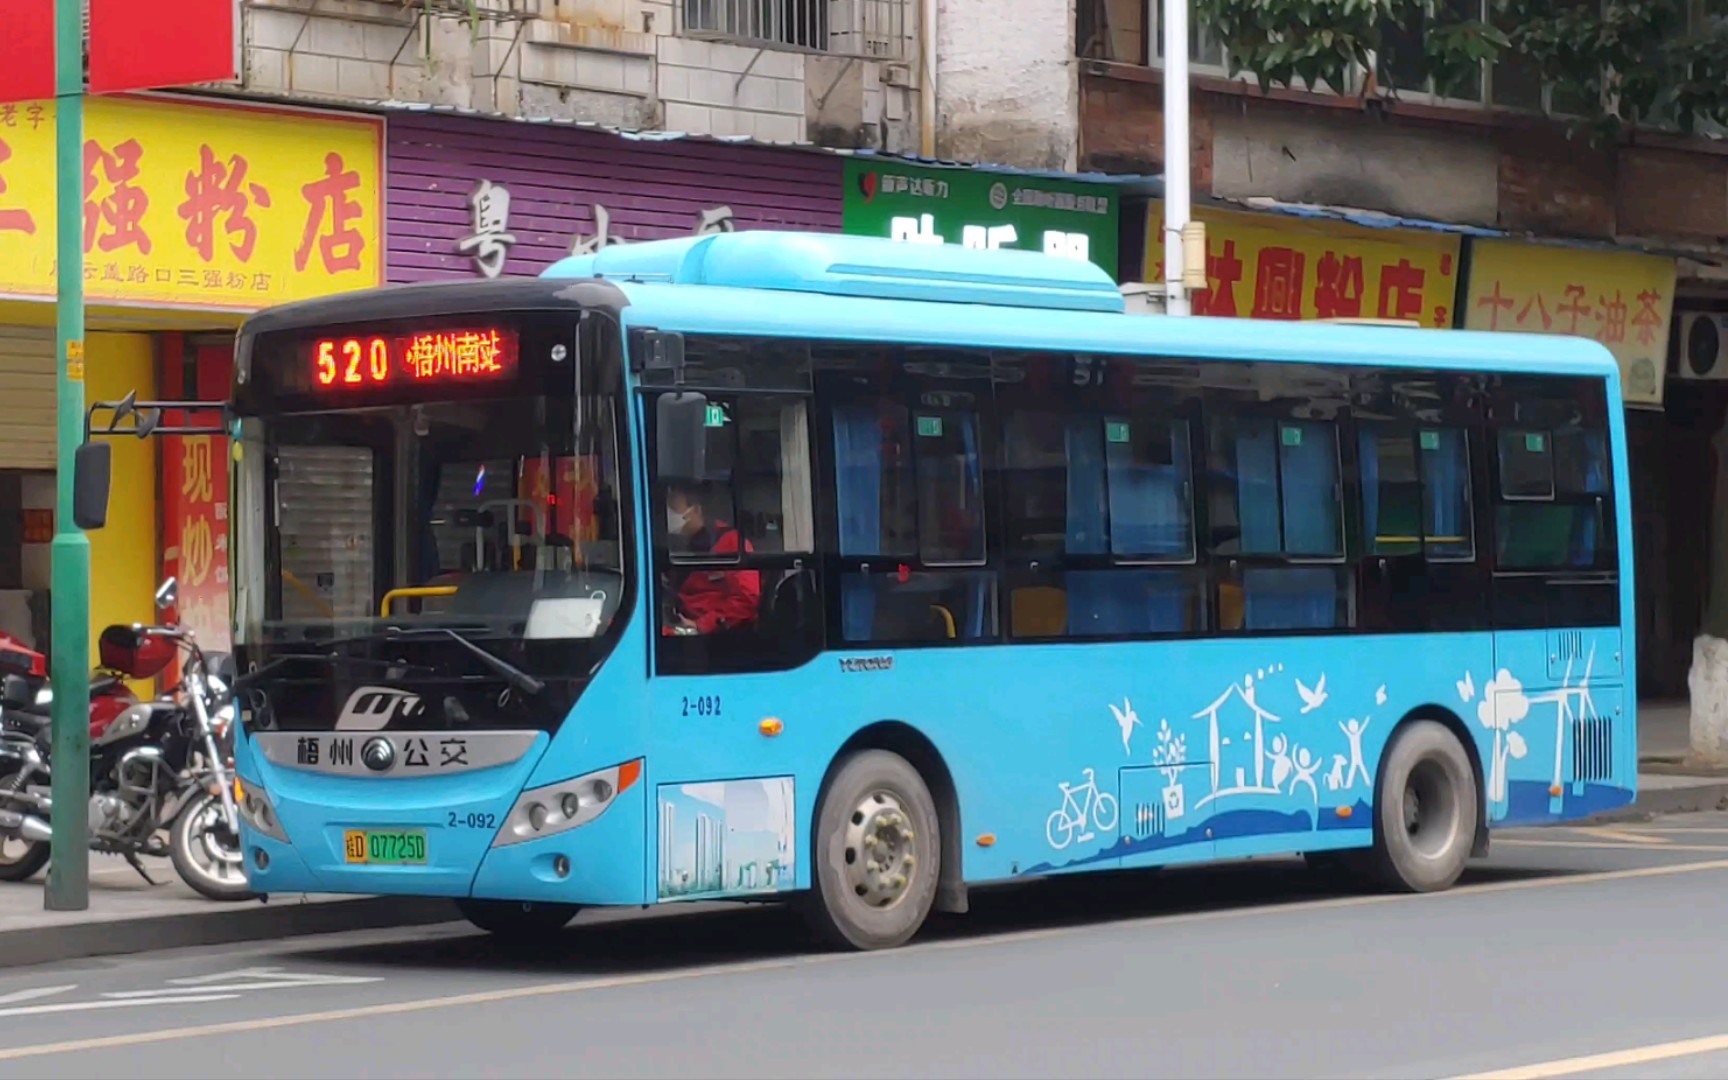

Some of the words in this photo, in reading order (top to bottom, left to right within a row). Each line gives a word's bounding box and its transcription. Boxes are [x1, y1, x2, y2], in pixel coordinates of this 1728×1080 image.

[0, 104, 57, 130] 老字
[1477, 280, 1663, 345] 十八子油茶
[318, 338, 388, 384] 520
[411, 329, 502, 378] 梧州南站
[682, 695, 722, 717] 2-092
[447, 811, 497, 830] 2-092
